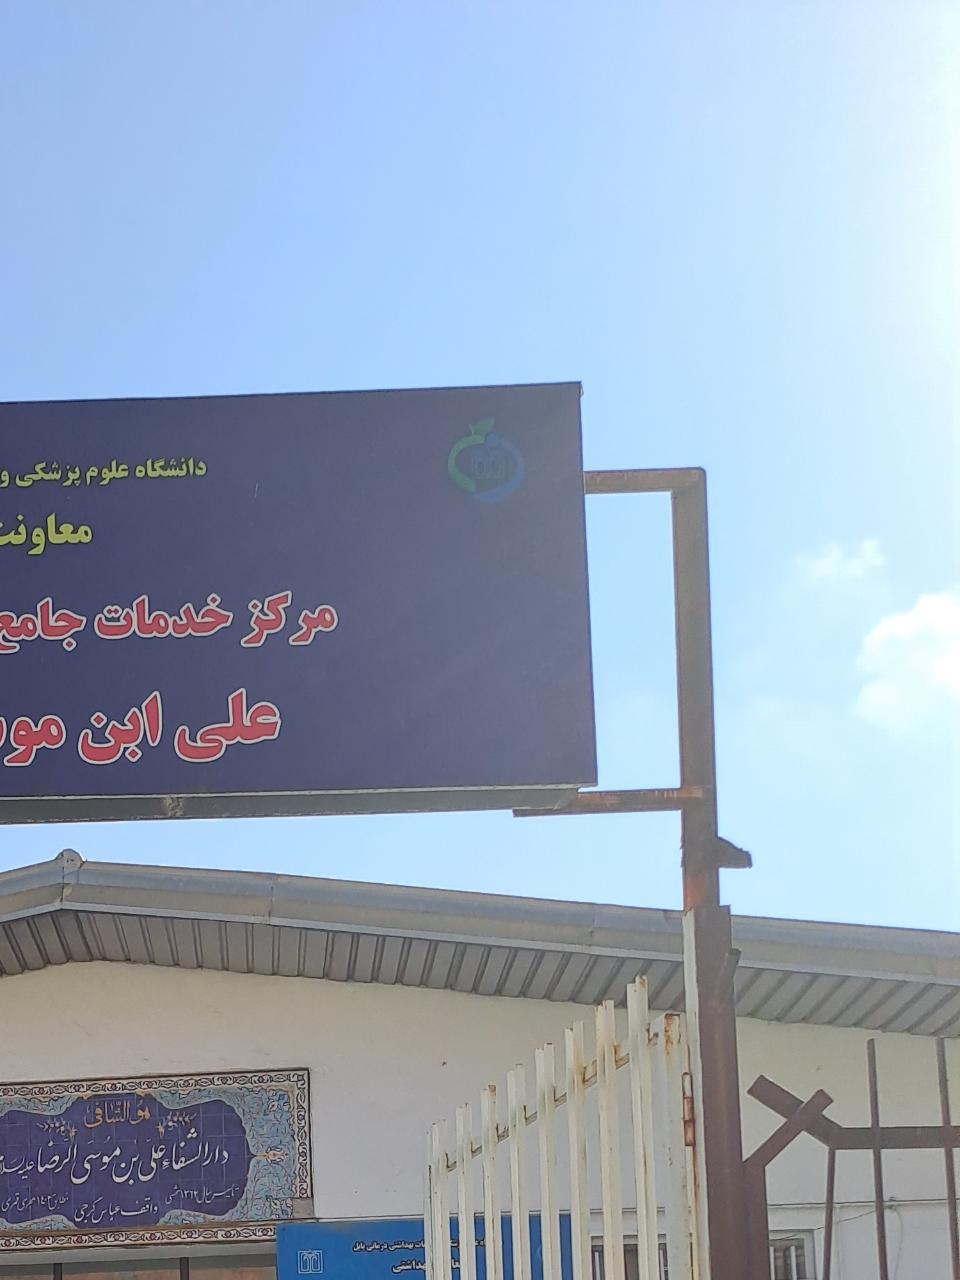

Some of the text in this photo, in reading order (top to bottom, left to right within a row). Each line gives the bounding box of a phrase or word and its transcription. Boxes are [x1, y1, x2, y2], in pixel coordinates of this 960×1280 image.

[0, 470, 10, 488] و
[15, 462, 81, 488] پزشکی
[86, 459, 129, 485] علوم
[134, 457, 207, 479] دانشگاه
[94, 593, 234, 640] خدمات
[240, 590, 339, 648] مرکز
[78, 690, 163, 765] ابن
[174, 687, 282, 763] علی
[389, 1240, 414, 1251] بهداشتی
